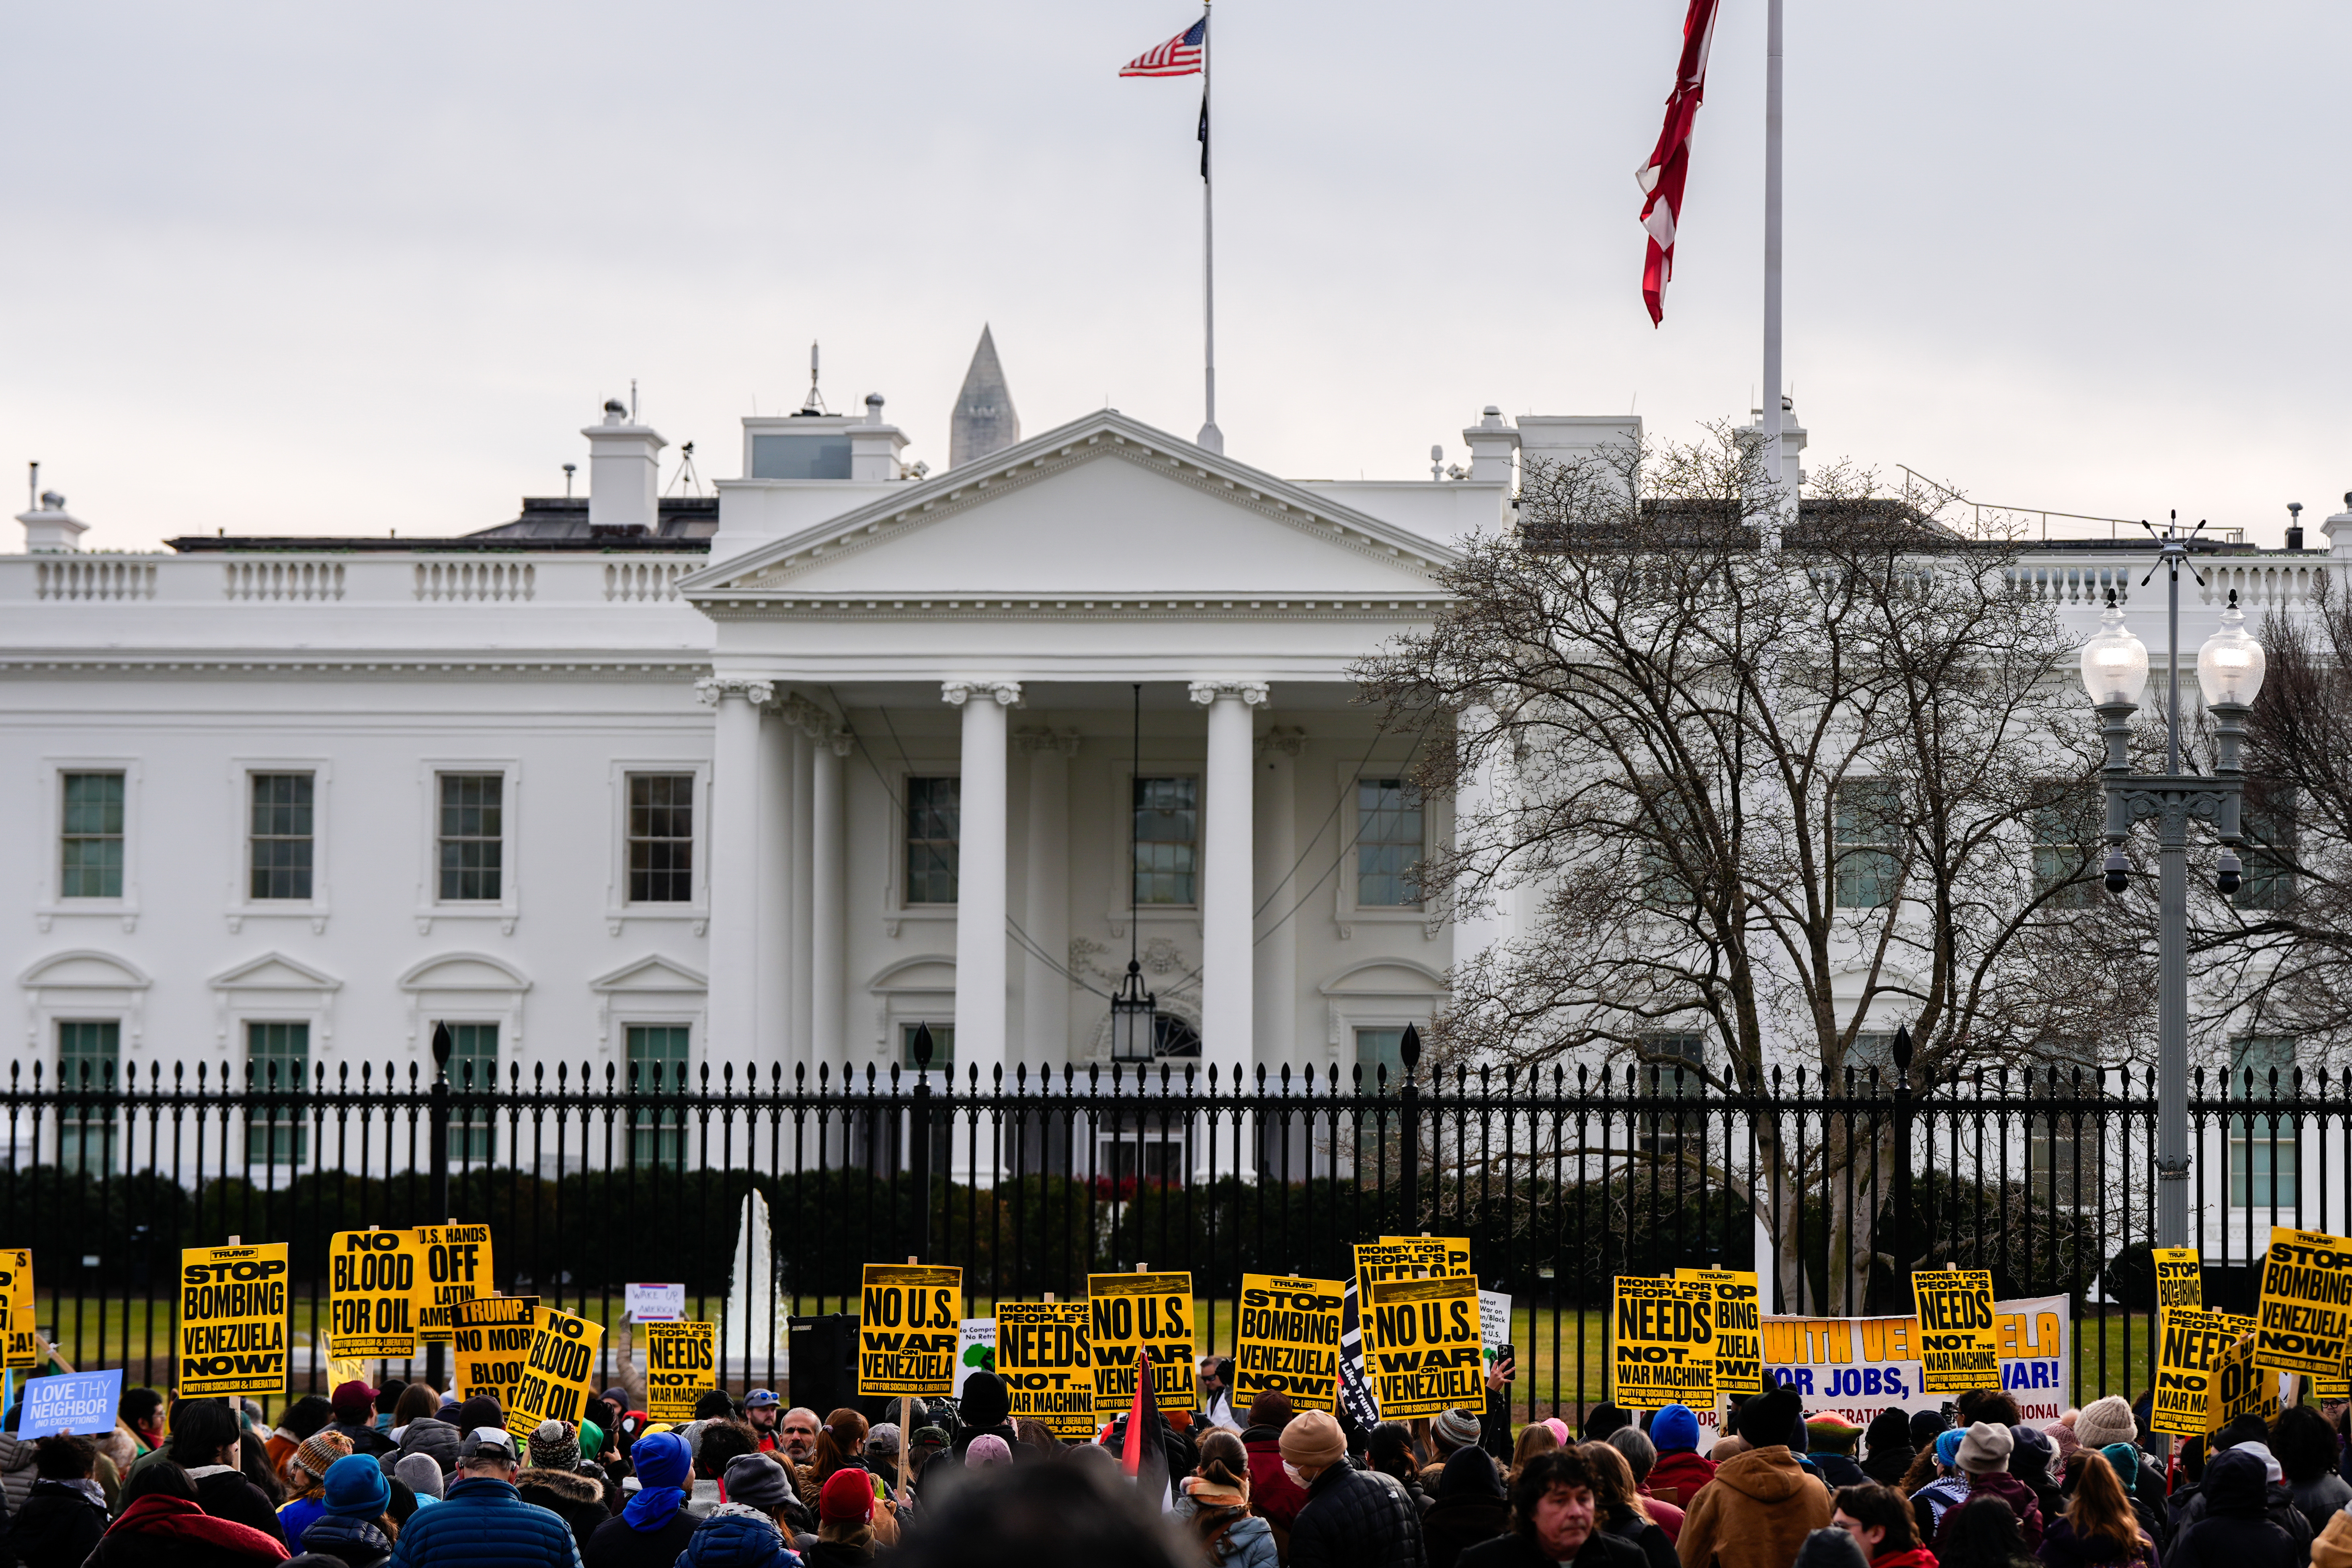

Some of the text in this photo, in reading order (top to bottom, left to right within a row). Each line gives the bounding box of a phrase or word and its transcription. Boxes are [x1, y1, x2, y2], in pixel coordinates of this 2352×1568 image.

[347, 1233, 399, 1252] NO
[417, 1227, 487, 1244] U.S. HANDS
[212, 1250, 256, 1258] TRUMP:
[1358, 1245, 1445, 1254] MONEY FOR
[1359, 1253, 1446, 1265] PEOPLE'S
[2270, 1242, 2352, 1271] STOP
[184, 1260, 285, 1284] STOP
[334, 1253, 413, 1292] BLOOD
[429, 1244, 478, 1282] OFF
[2158, 1262, 2198, 1278] STOP
[1272, 1280, 1314, 1290] TRUMP:
[1618, 1279, 1711, 1291] MONEY FOR
[1915, 1272, 1960, 1281] MONEY
[1916, 1280, 1989, 1290] PEOPLE'S
[2264, 1263, 2352, 1306] BOMBING
[184, 1281, 284, 1320] BOMBING
[434, 1285, 475, 1305] LATIN
[633, 1289, 658, 1299] WAKE
[1244, 1289, 1343, 1312] STOP
[1618, 1287, 1712, 1301] PEOPLE'S
[332, 1299, 370, 1335] FOR
[375, 1298, 414, 1334] OIL
[457, 1299, 529, 1323] TRUMP:
[863, 1287, 958, 1329] NO U.S.
[999, 1304, 1058, 1312] MONEY
[1000, 1314, 1089, 1323] PEOPLE'S
[1092, 1296, 1191, 1340] NO U.S.
[1918, 1289, 1992, 1330] NEEDS
[2169, 1309, 2257, 1326] MONEY FOR
[548, 1312, 584, 1338] NO
[1241, 1308, 1339, 1346] BOMBING
[1376, 1300, 1478, 1348] NO U.S.
[1618, 1298, 1712, 1344] NEEDS
[2262, 1301, 2347, 1339] VENEZUELA
[184, 1322, 283, 1355] VENEZUELA
[333, 1340, 344, 1348] PARTY
[351, 1338, 375, 1347] SOCIALISM
[455, 1329, 482, 1352] NO
[863, 1332, 957, 1353] WAR
[1000, 1324, 1091, 1368] NEEDS
[1761, 1320, 1853, 1364] WITH
[1861, 1312, 2060, 1362] VENELA
[1921, 1335, 1976, 1351] NOT
[2258, 1330, 2344, 1360] NOW!
[333, 1347, 411, 1356] PSLWEB.ORG
[529, 1330, 591, 1383] BLOOD
[650, 1338, 712, 1370] NEEDS
[1093, 1344, 1193, 1366] WAR
[1240, 1344, 1336, 1377] VENEZUELA
[1378, 1348, 1480, 1373] WAR
[1618, 1346, 1689, 1364] NOT
[1923, 1351, 1997, 1371] WAR MACHINE
[2213, 1351, 2235, 1373] U.S.
[183, 1353, 283, 1377] NOW!
[862, 1353, 953, 1379] VENEZUELA
[1341, 1362, 1357, 1387] Like
[2257, 1354, 2338, 1373] PARTY FOR SOCIALISM & LIBERATION
[183, 1378, 281, 1393] PARTY FOR SOCIALISM & LIBERATION
[650, 1373, 697, 1386] NOT
[862, 1382, 880, 1390] PARTY
[881, 1383, 890, 1391] FOR
[890, 1383, 917, 1392] SOCIALISM
[924, 1383, 950, 1391] LIBERATION
[999, 1373, 1070, 1390] NOT
[1237, 1372, 1335, 1396] NOW!
[1380, 1369, 1483, 1402] VENEZUELA
[1617, 1365, 1713, 1387] WAR MACHINE
[1735, 1381, 1759, 1390] LIBERATION
[1824, 1367, 1909, 1400] JOBS,
[1928, 1381, 1999, 1390] PSLWEB.ORG
[32, 1379, 111, 1404] LOVE THY
[515, 1373, 579, 1427] FOR OIL
[650, 1388, 671, 1402] WAR
[1034, 1392, 1092, 1413] MACHINE
[1162, 1396, 1192, 1406] LIBERATION
[1237, 1394, 1254, 1403] PARTY
[1619, 1388, 1635, 1396] PARTY
[1636, 1389, 1646, 1397] FOR
[1646, 1390, 1674, 1398] SOCIALISM
[1682, 1390, 1712, 1399] LIBERATION
[2158, 1390, 2188, 1411] WAR
[30, 1398, 107, 1420] NEIGHBOR
[1097, 1399, 1126, 1408] PARTY FOR
[1301, 1400, 1331, 1410] LIBERATION
[1355, 1386, 1376, 1421] Trump
[1383, 1406, 1401, 1415] PARTY
[1401, 1405, 1411, 1414] FOR
[1412, 1402, 1441, 1412] SOCIALISM
[1442, 1402, 1449, 1410] &
[2223, 1385, 2262, 1423] LATIN
[35, 1415, 99, 1429] (NO EXCEPTIONS)
[1063, 1417, 1093, 1425] LIBERATION
